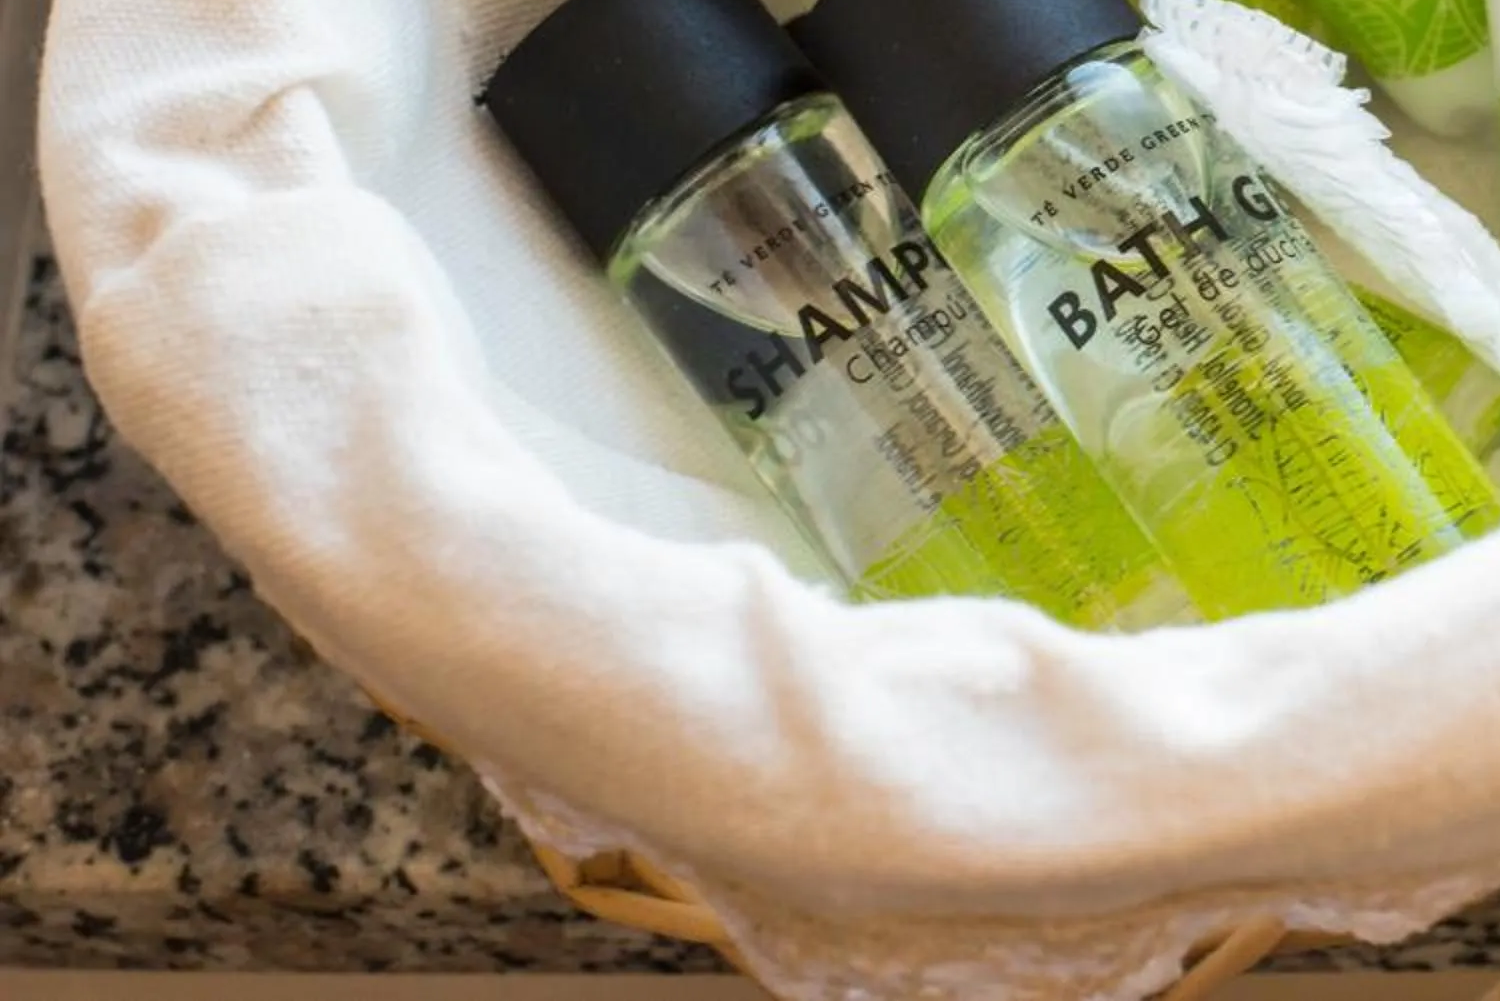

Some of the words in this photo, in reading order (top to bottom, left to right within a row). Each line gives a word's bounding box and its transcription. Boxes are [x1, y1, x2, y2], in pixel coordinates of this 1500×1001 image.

[1030, 199, 1057, 226] TÉ
[1063, 149, 1134, 199] VERDE
[1141, 117, 1200, 151] GREEN
[1047, 196, 1231, 351] BATH
[1194, 265, 1240, 301] de
[728, 237, 948, 420] SHAMP
[846, 293, 967, 384] Champú
